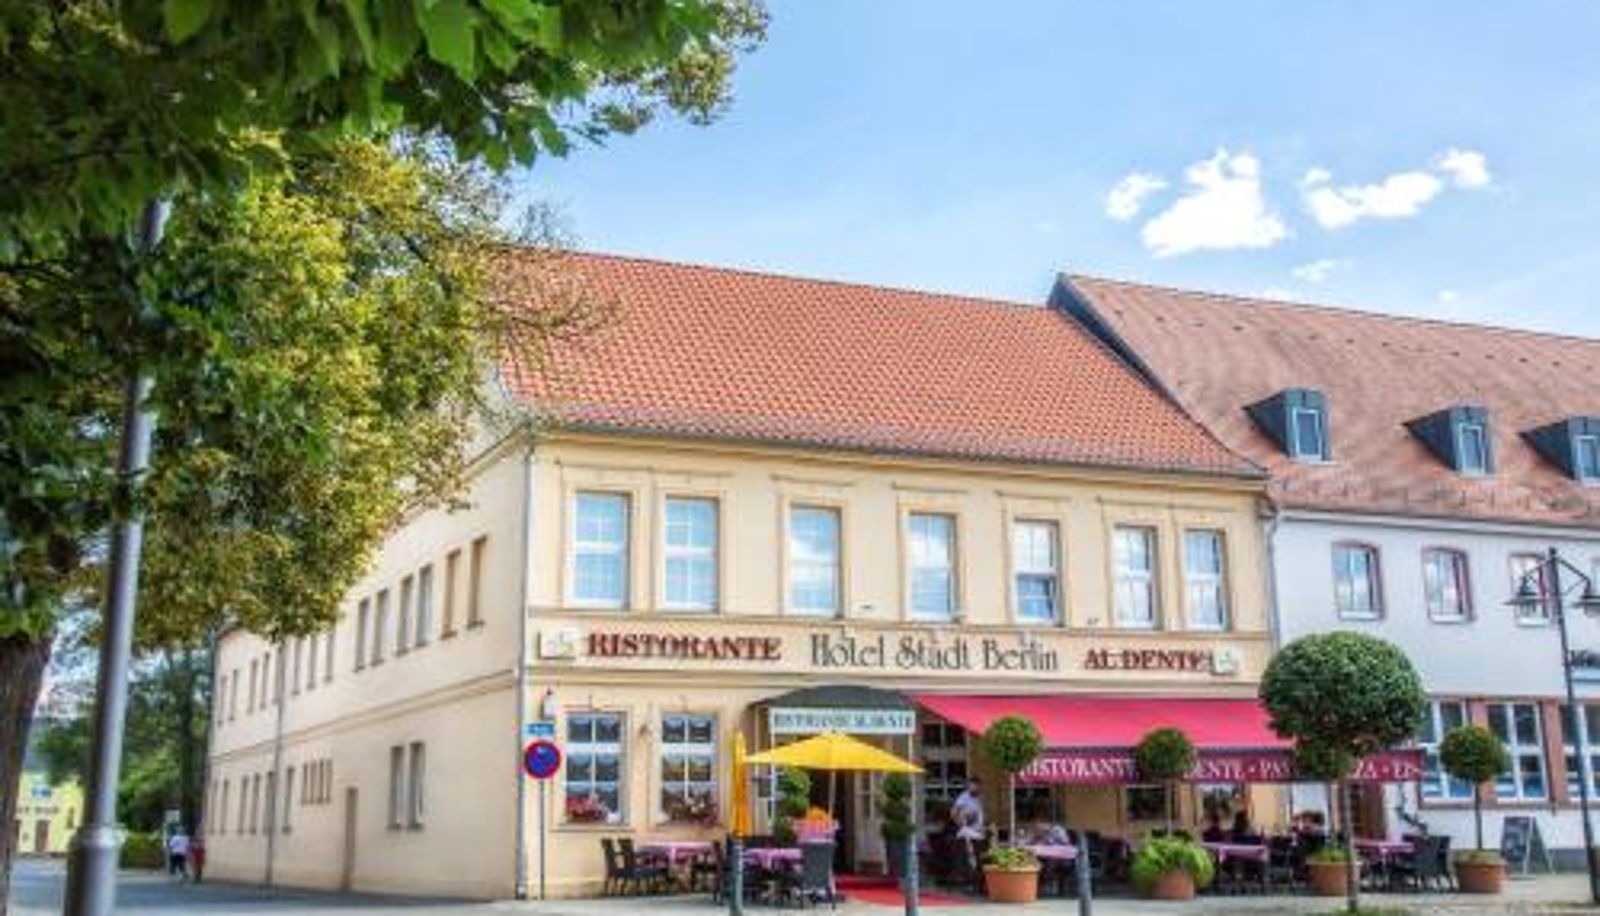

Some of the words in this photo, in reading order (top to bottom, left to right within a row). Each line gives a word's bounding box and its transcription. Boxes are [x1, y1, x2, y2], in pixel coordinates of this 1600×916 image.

[588, 632, 782, 661] RISTORANTE
[896, 637, 969, 670] Stadt
[982, 639, 1059, 672] Berlin
[1084, 649, 1115, 669] AL
[1121, 650, 1205, 672] DENTE
